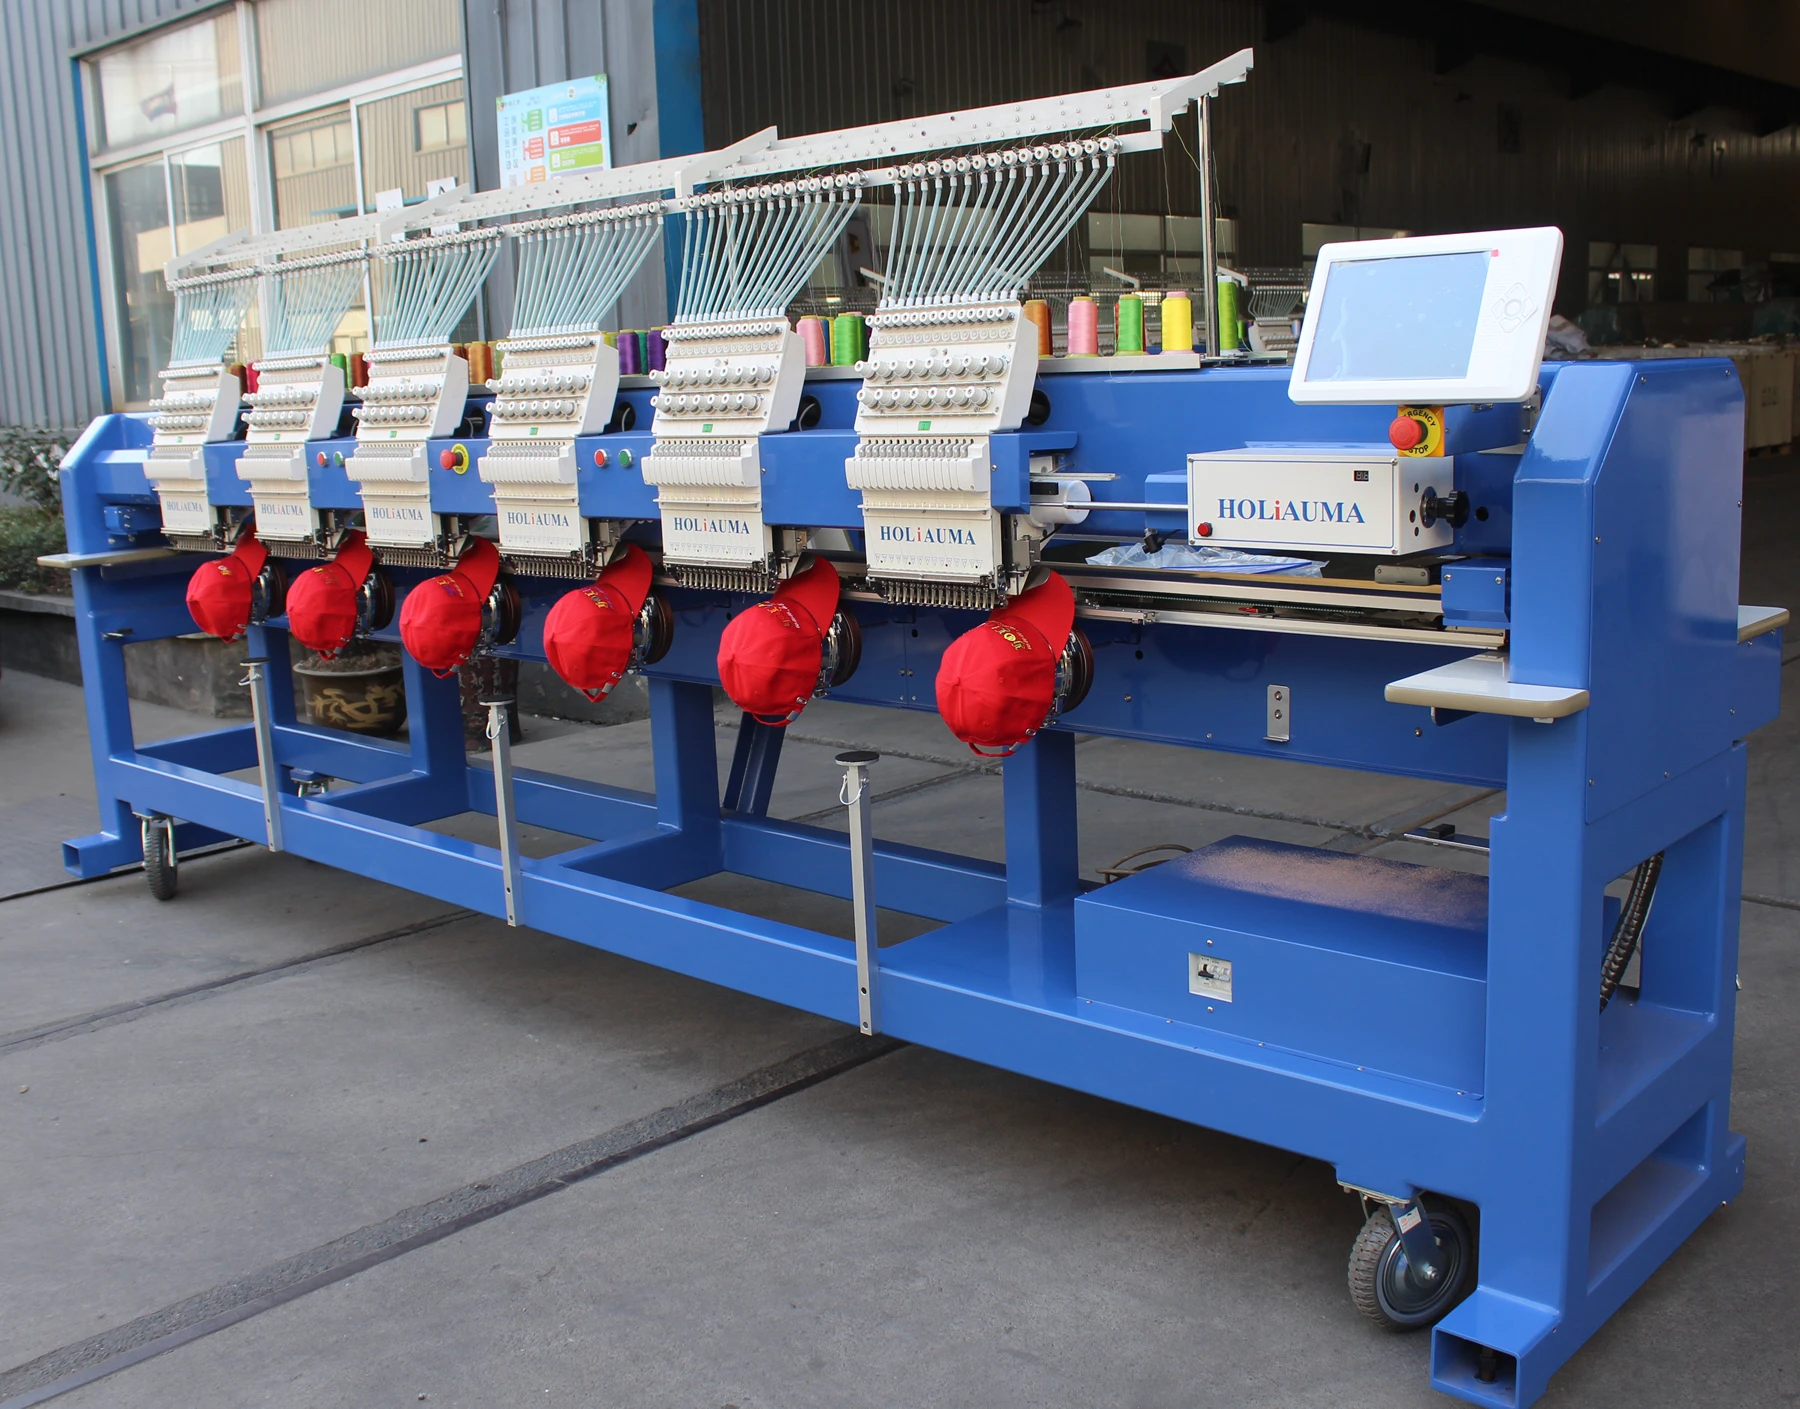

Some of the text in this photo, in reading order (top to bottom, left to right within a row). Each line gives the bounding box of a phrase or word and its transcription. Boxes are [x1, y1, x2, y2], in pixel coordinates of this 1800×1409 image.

[507, 512, 569, 526] HOLiAUMA
[1217, 498, 1366, 524] HOLiAUMA
[674, 517, 750, 534] HOLiAUMA
[880, 526, 976, 545] HOLiAUMA
